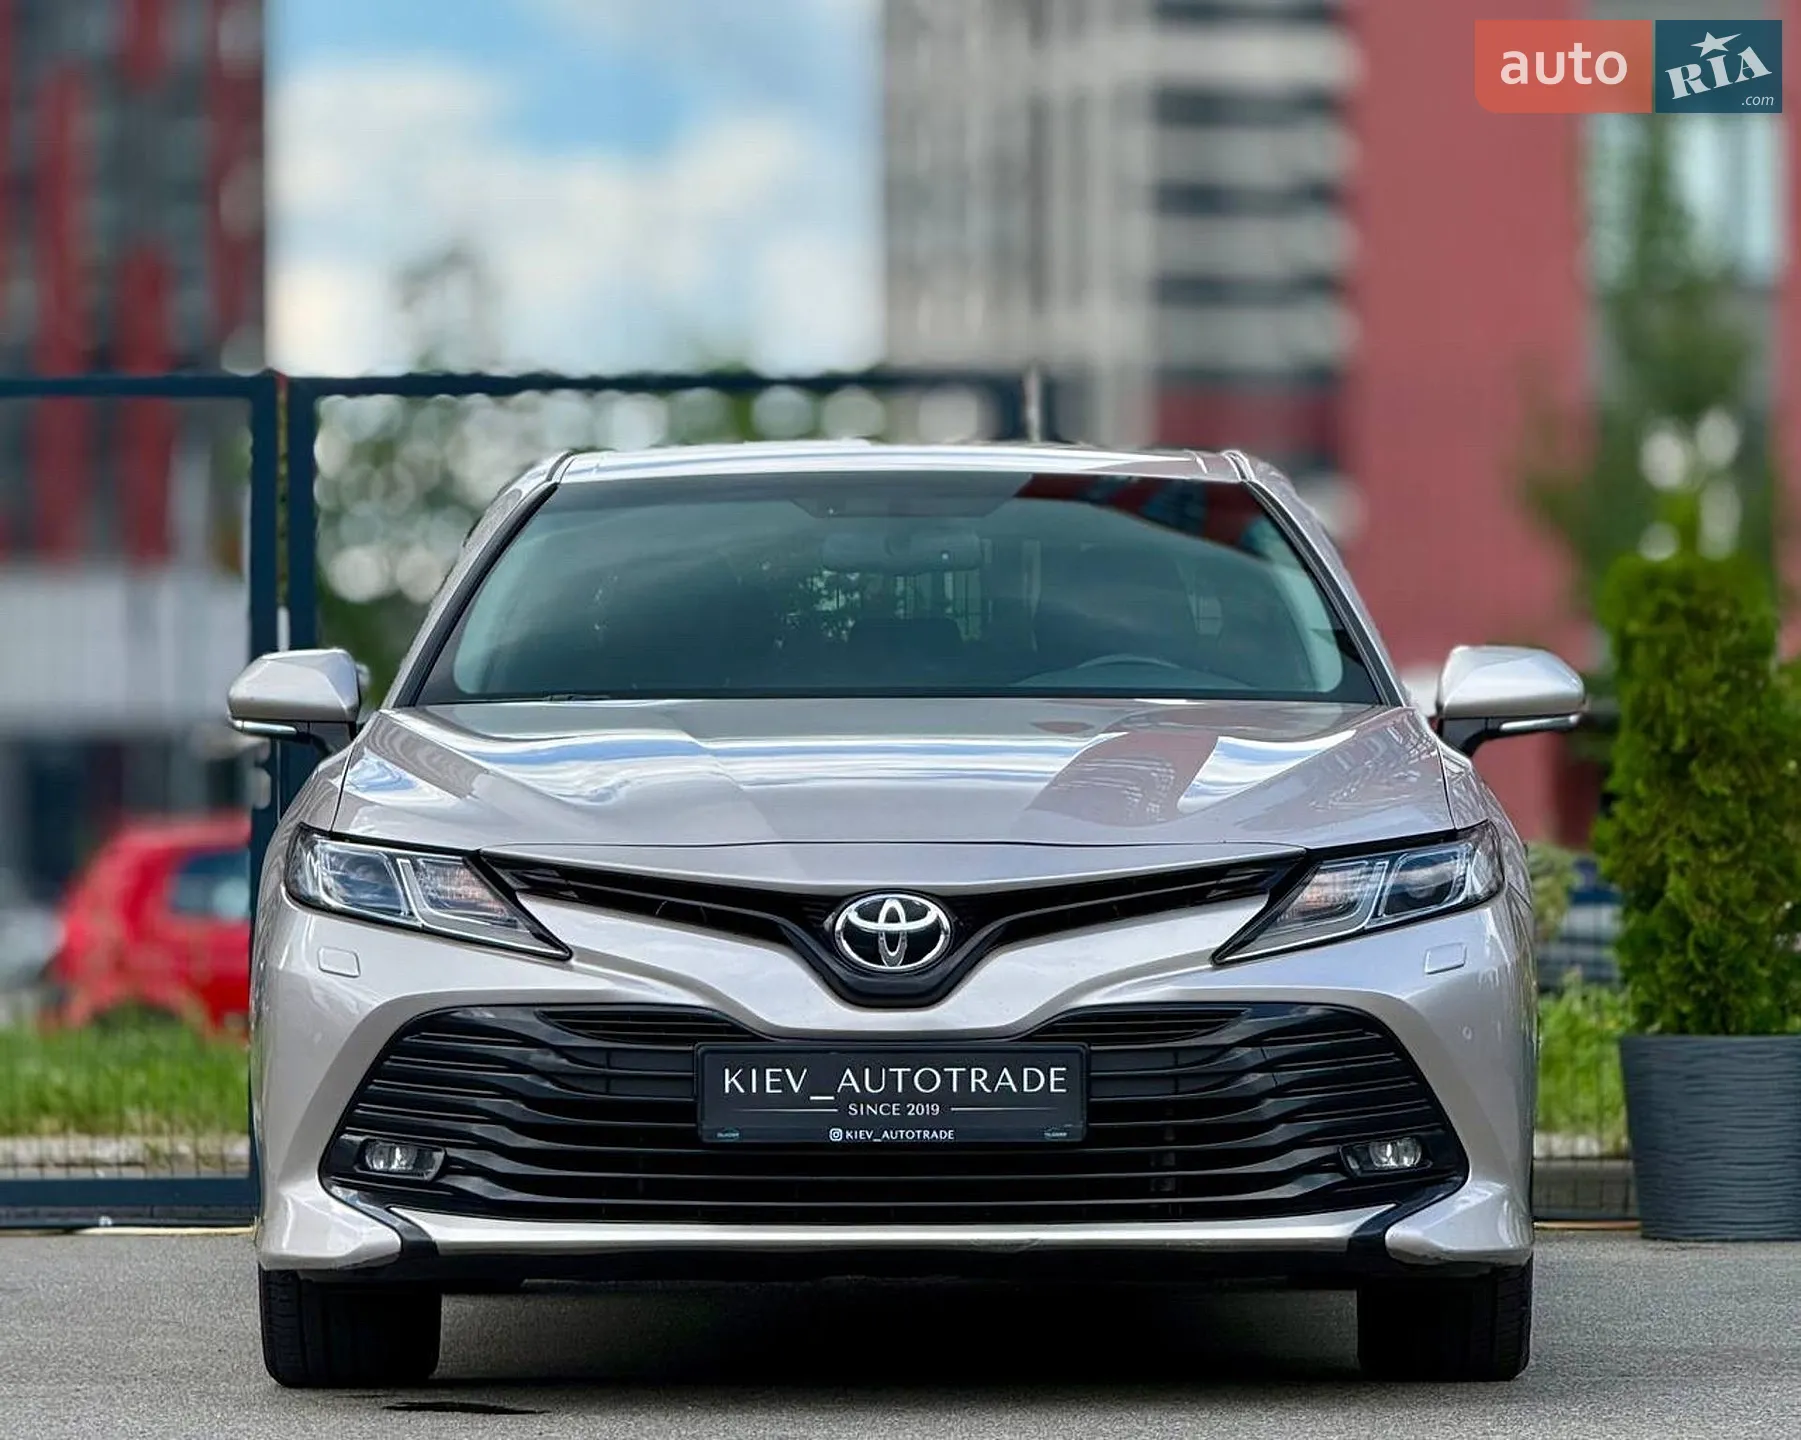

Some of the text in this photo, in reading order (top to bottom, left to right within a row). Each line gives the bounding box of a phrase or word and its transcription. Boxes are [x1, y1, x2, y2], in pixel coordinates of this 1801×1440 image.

[723, 1067, 1067, 1100] KIEV_AUTOTRADE
[847, 1102, 941, 1116] SINCE 2019
[844, 1130, 955, 1142] KIEV_AUTOTRADE
